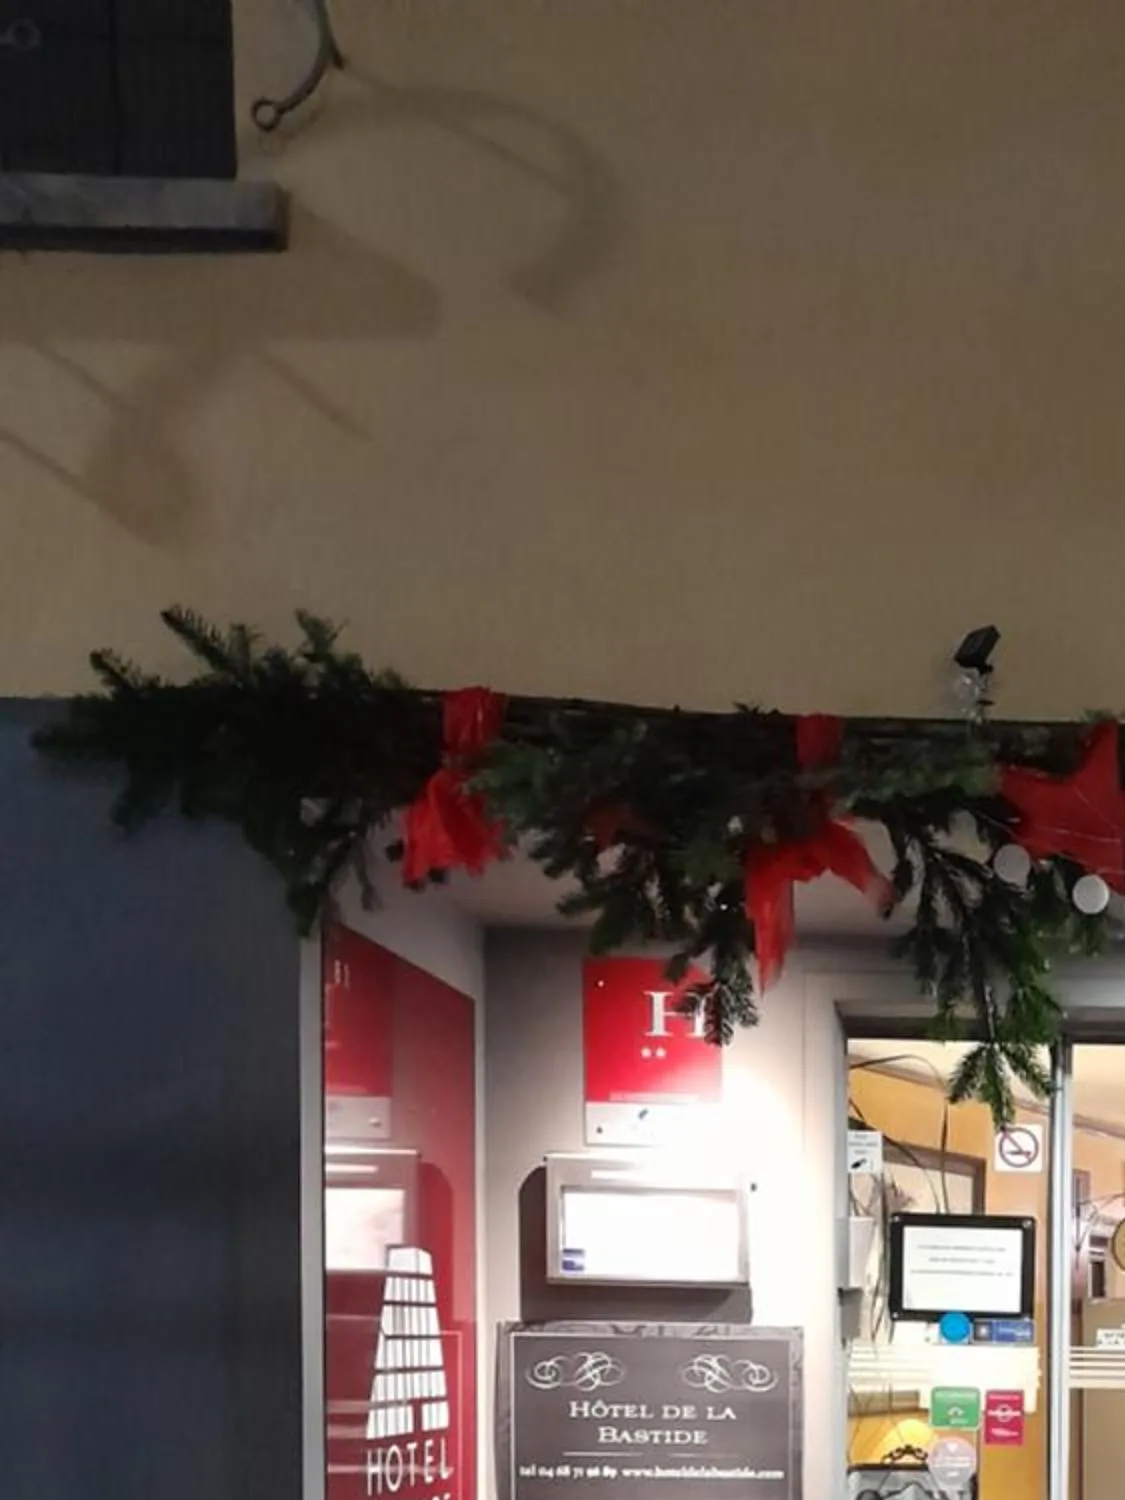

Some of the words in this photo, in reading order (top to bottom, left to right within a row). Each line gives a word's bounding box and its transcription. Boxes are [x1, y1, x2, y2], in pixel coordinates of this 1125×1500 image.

[569, 1399, 655, 1419] HÔTEL
[661, 1404, 698, 1420] DE
[706, 1406, 737, 1421] LA
[597, 1426, 709, 1445] BASTIDE
[366, 1437, 455, 1497] HOTEL
